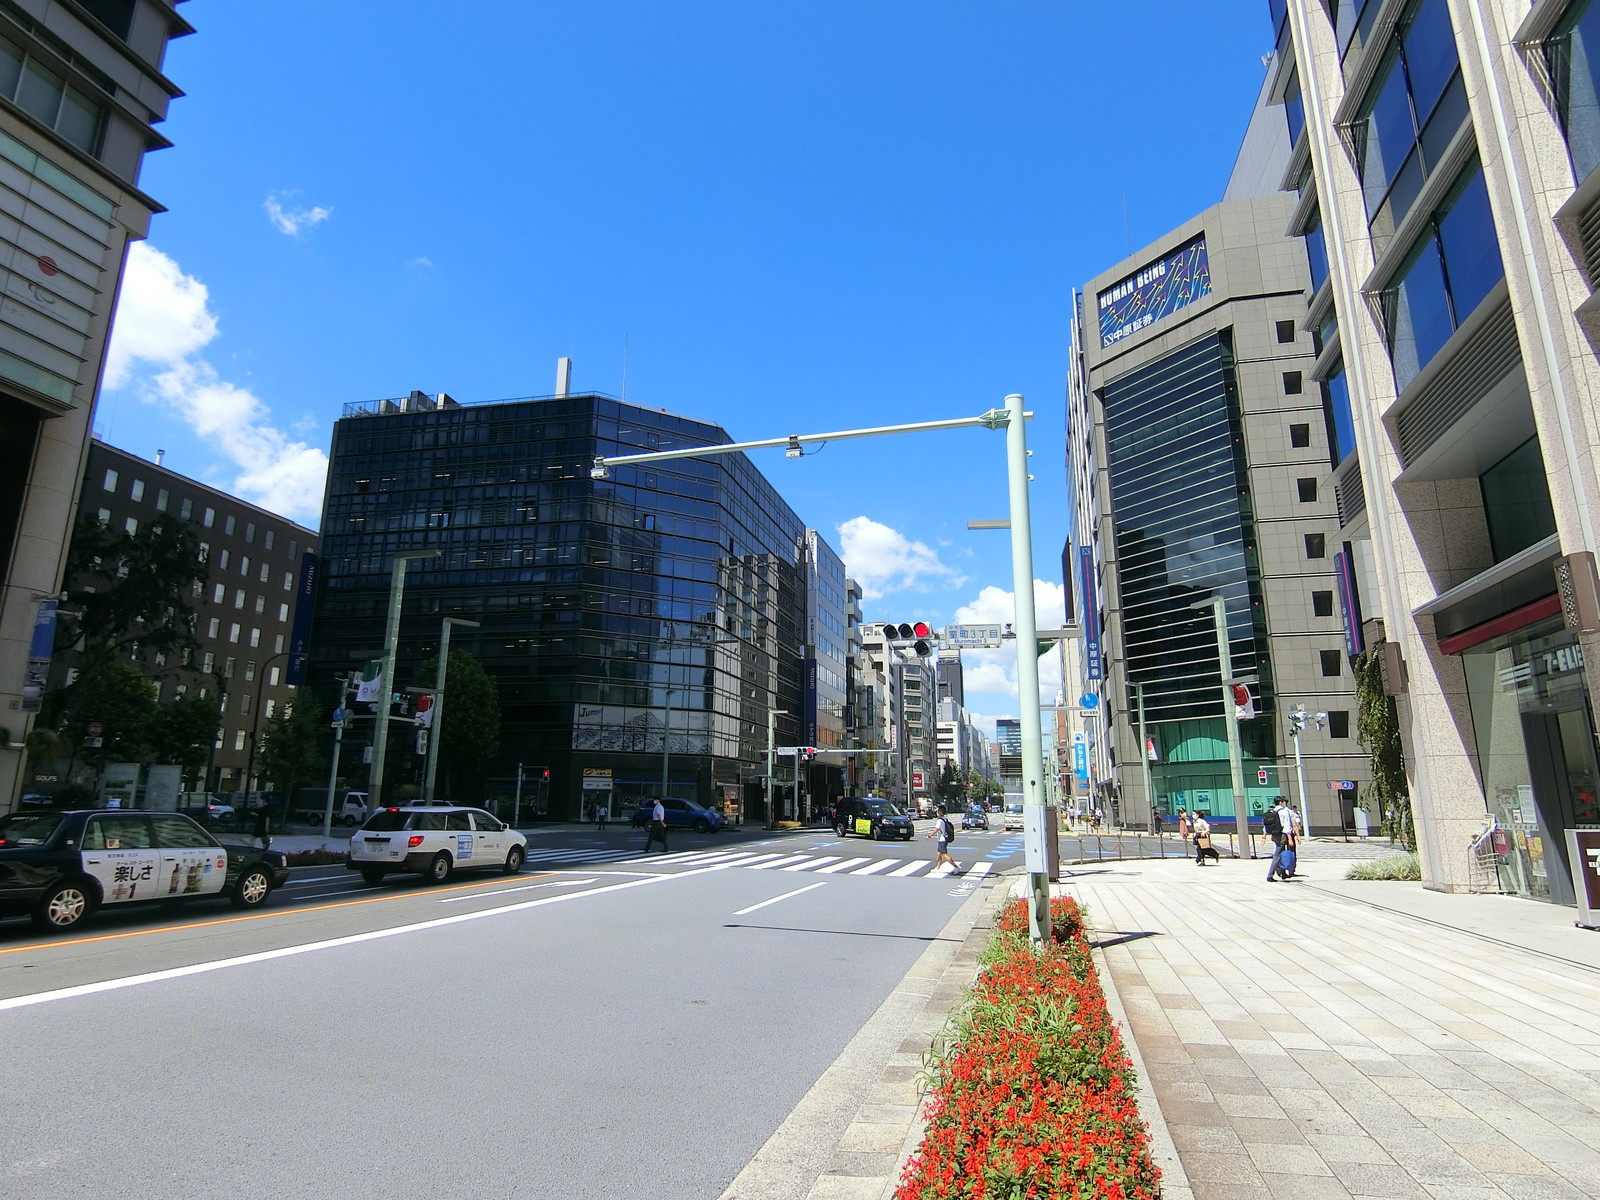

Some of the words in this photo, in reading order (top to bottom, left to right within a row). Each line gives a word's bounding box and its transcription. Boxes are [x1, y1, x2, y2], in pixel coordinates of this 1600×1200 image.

[1100, 279, 1134, 310] HUMAN
[1136, 261, 1166, 289] BEING
[1114, 313, 1153, 341] 中原証券
[306, 565, 315, 595] MIZUHO
[948, 629, 998, 639] 室町3丁目
[1089, 642, 1099, 677] 中原証券
[114, 864, 154, 882] 楽しさ
